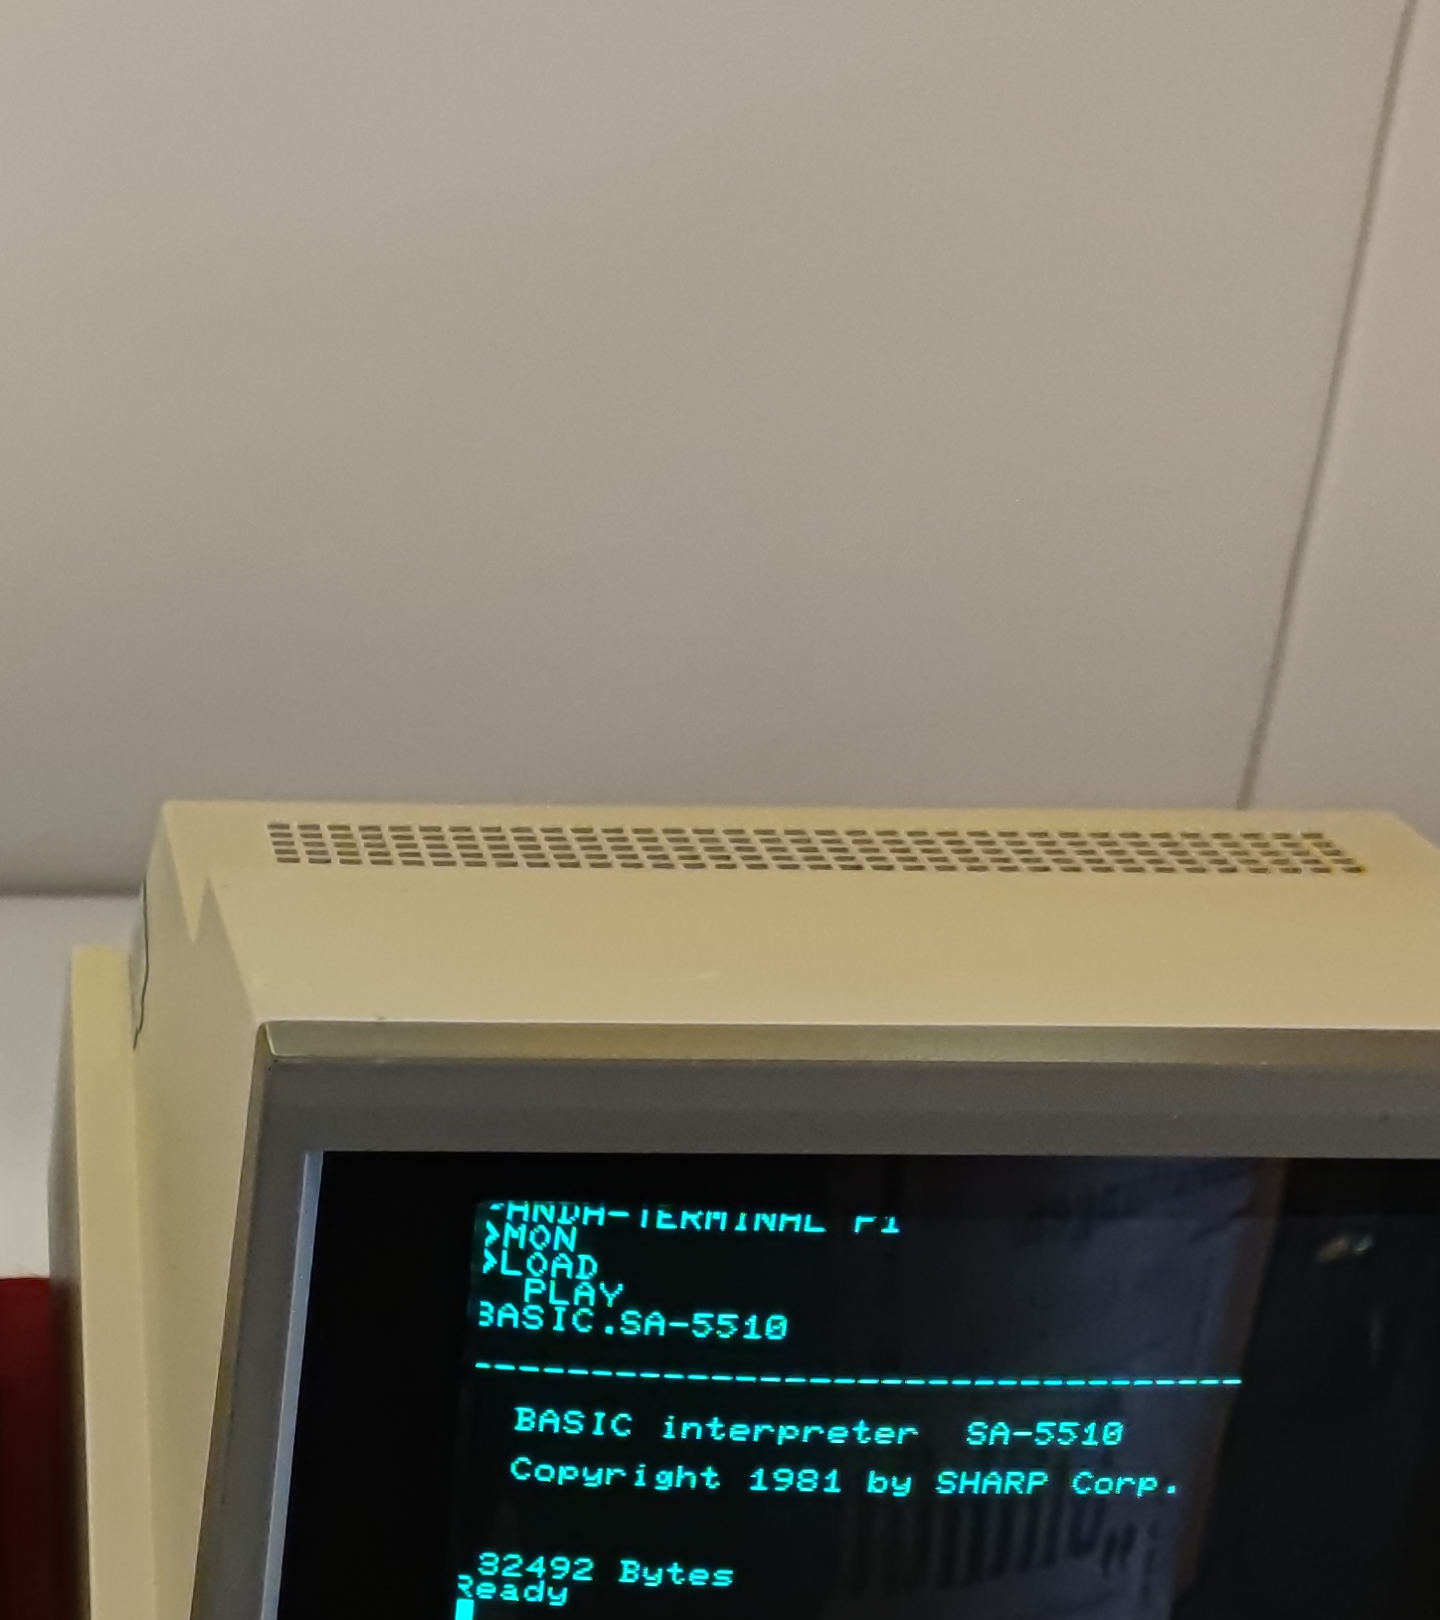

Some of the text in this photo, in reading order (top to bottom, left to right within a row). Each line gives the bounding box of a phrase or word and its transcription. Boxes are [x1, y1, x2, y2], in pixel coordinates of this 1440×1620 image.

[525, 1279, 623, 1307] PLAY
[514, 1407, 1124, 1446] BASIC interpreter SA-5510
[510, 1457, 1177, 1498] Copyright 1981 by SHARP Corp.
[618, 1559, 734, 1587] Bytes
